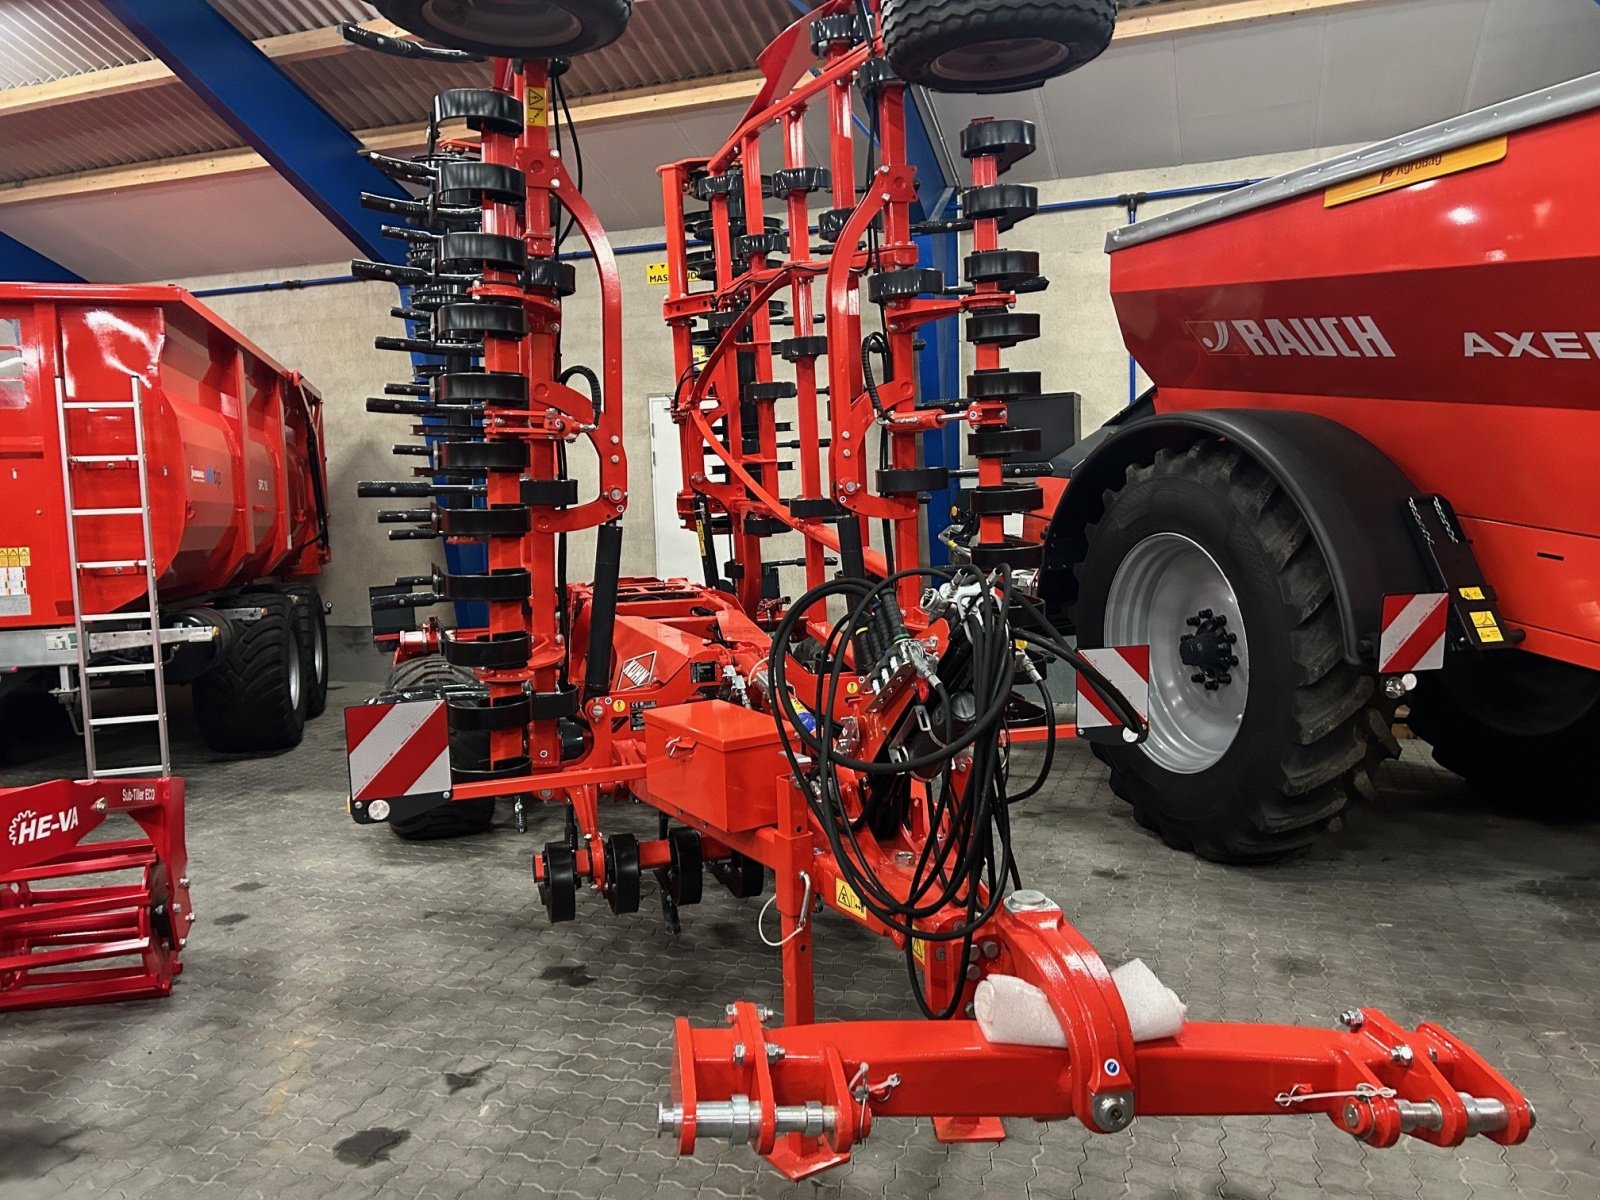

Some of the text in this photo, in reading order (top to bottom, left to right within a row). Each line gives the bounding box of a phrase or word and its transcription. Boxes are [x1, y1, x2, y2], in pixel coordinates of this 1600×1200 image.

[1231, 315, 1397, 358] RAUCH
[622, 659, 651, 687] KUHN
[122, 788, 155, 802] Sub-Tiller ECO
[17, 805, 79, 845] HE-VA
